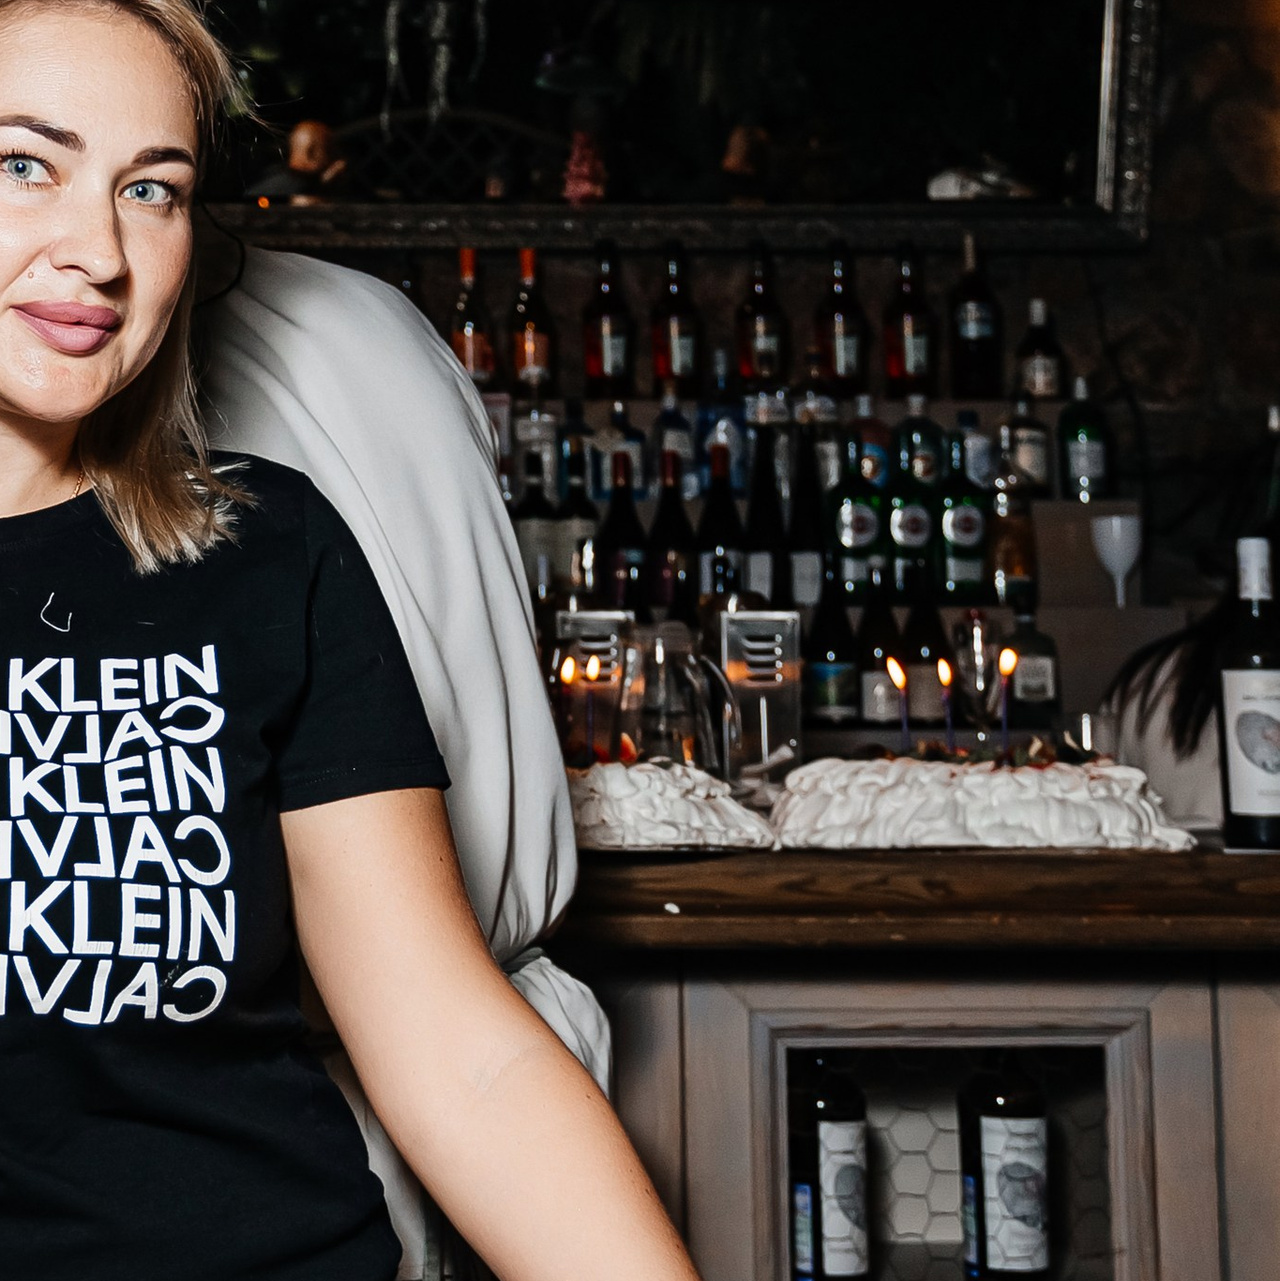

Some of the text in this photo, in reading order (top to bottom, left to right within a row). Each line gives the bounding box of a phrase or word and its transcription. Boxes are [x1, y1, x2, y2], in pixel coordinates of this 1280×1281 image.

[9, 645, 219, 713] KLEIN
[9, 746, 226, 818] KLEIN
[9, 881, 236, 962] KLEIN
